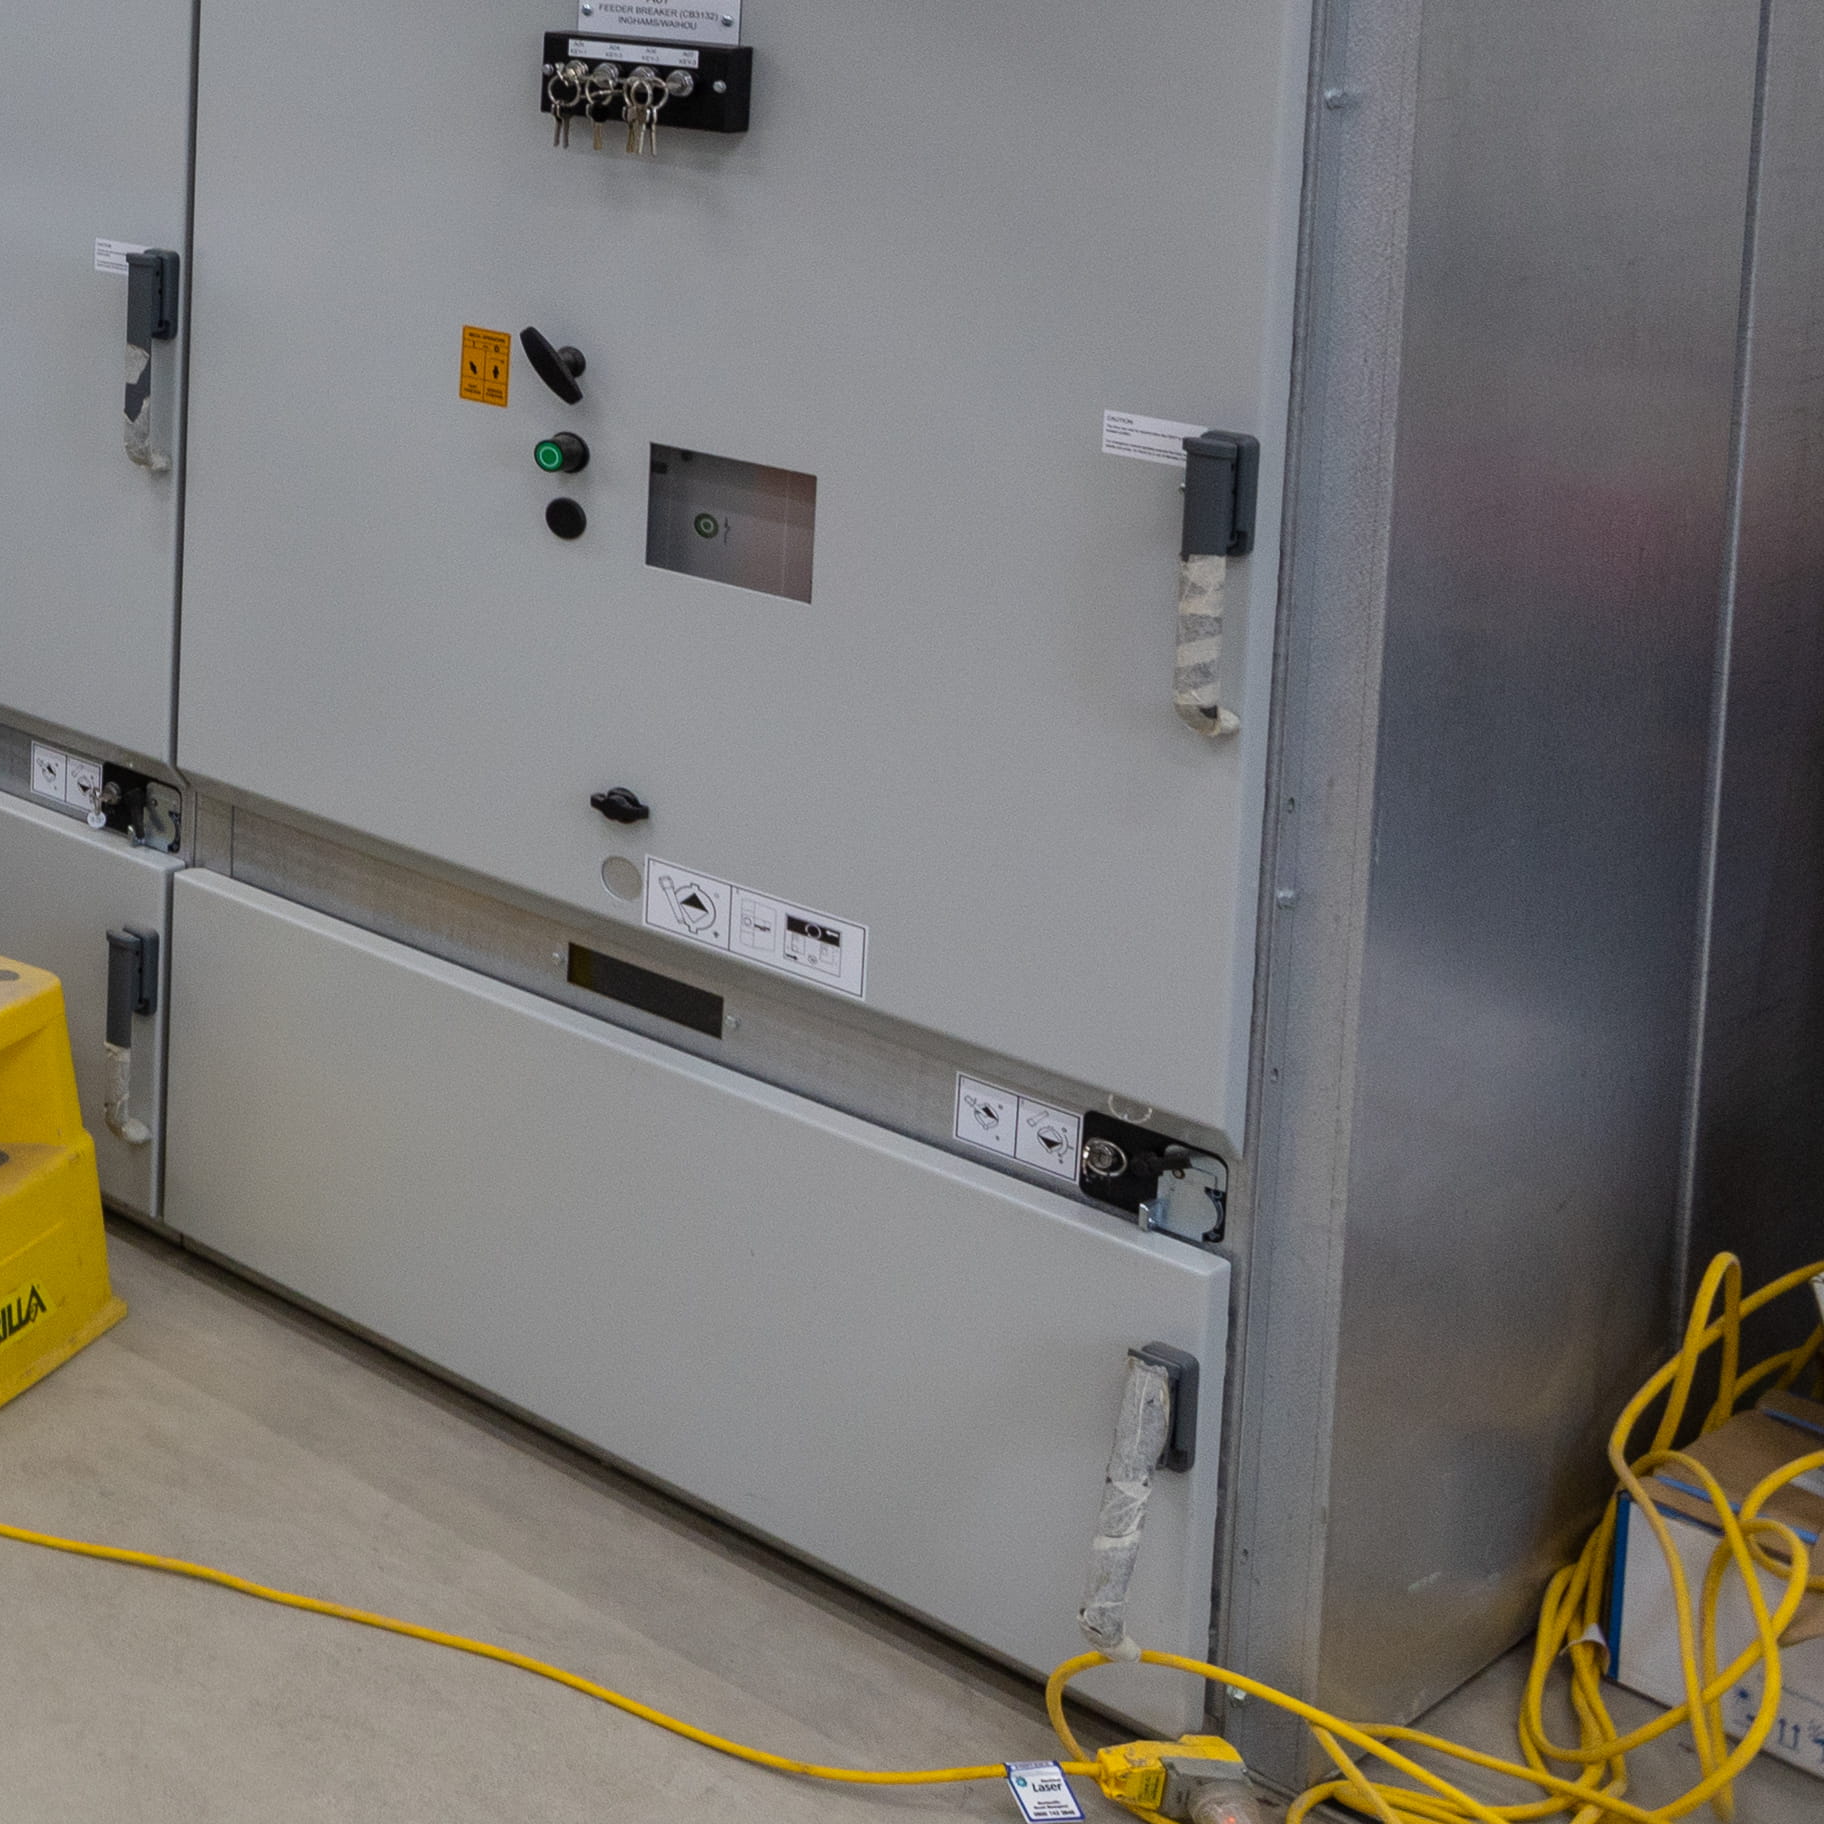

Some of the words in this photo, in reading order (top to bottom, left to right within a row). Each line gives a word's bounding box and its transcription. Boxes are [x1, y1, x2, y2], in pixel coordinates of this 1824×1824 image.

[599, 4, 634, 17] FEEDER
[635, 7, 678, 19] BREAKER
[1032, 1782, 1062, 1793] Laser
